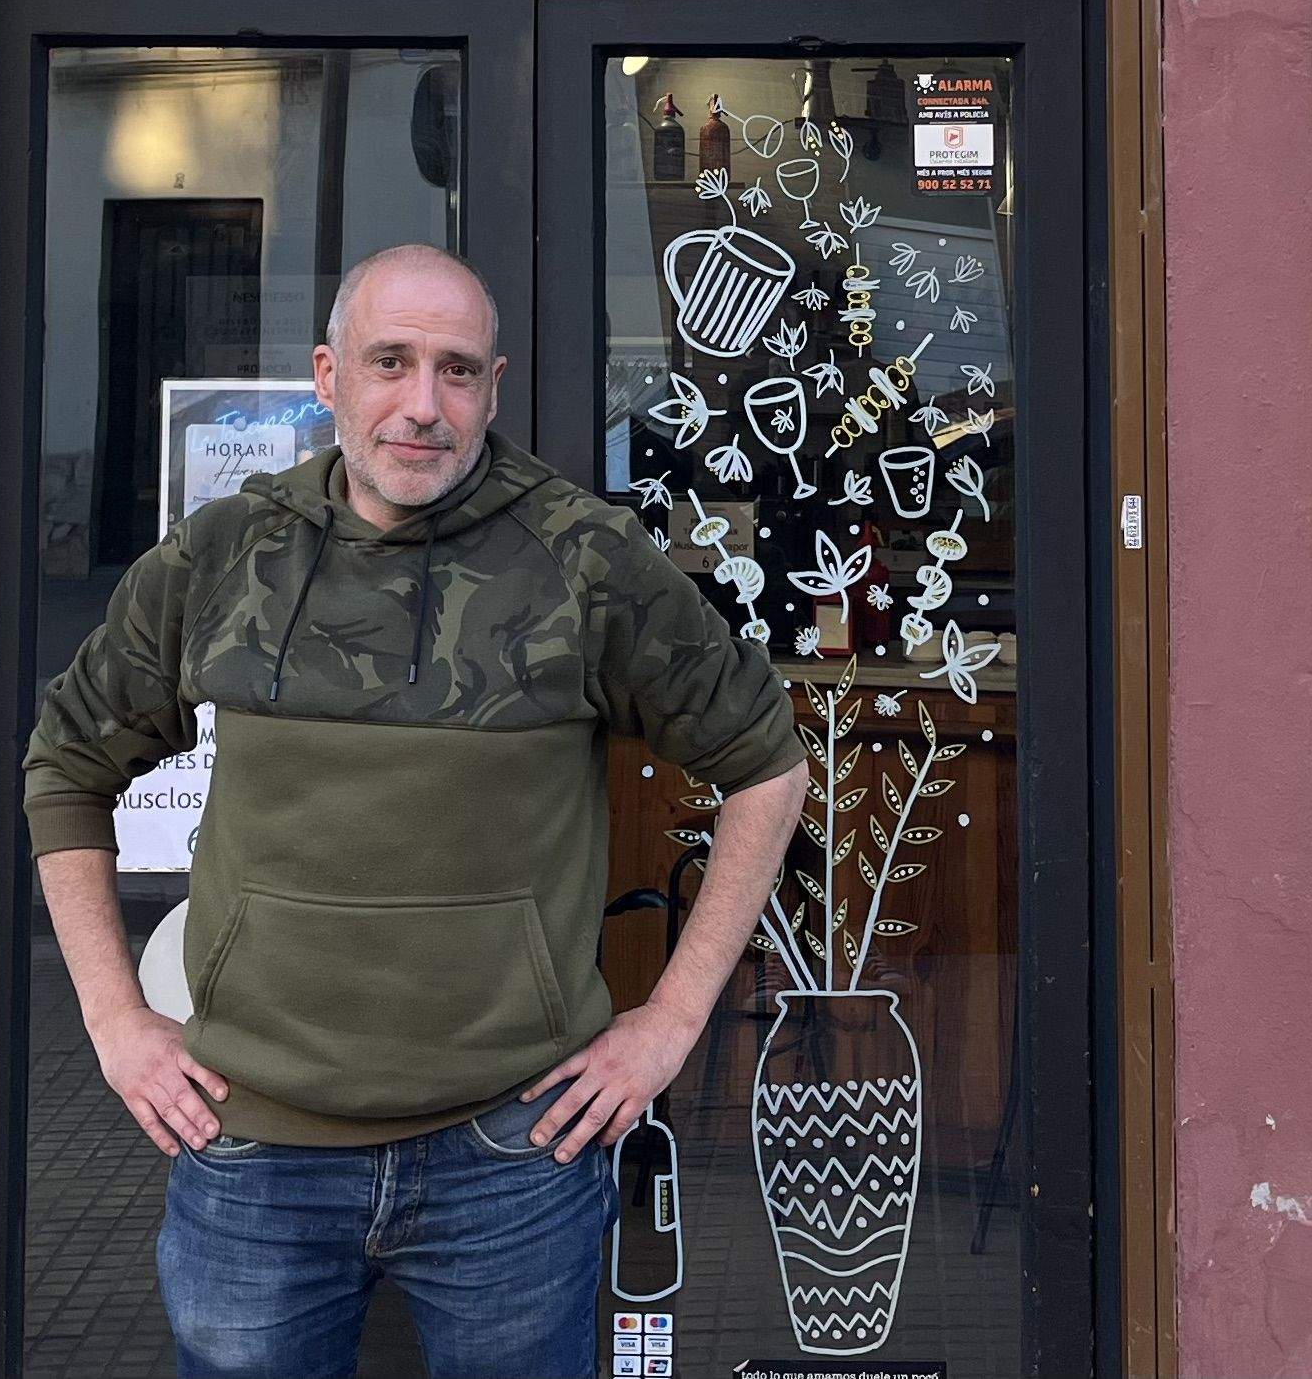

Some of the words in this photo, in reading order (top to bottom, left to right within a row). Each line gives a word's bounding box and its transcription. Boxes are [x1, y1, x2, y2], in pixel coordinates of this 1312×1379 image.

[938, 79, 993, 92] ALARMA
[929, 150, 979, 159] PROTEGIM
[917, 179, 940, 190] 900
[942, 179, 957, 190] 52
[959, 179, 975, 190] 52
[977, 179, 993, 190] 71
[205, 443, 274, 457] HORARI
[158, 753, 197, 770] PES
